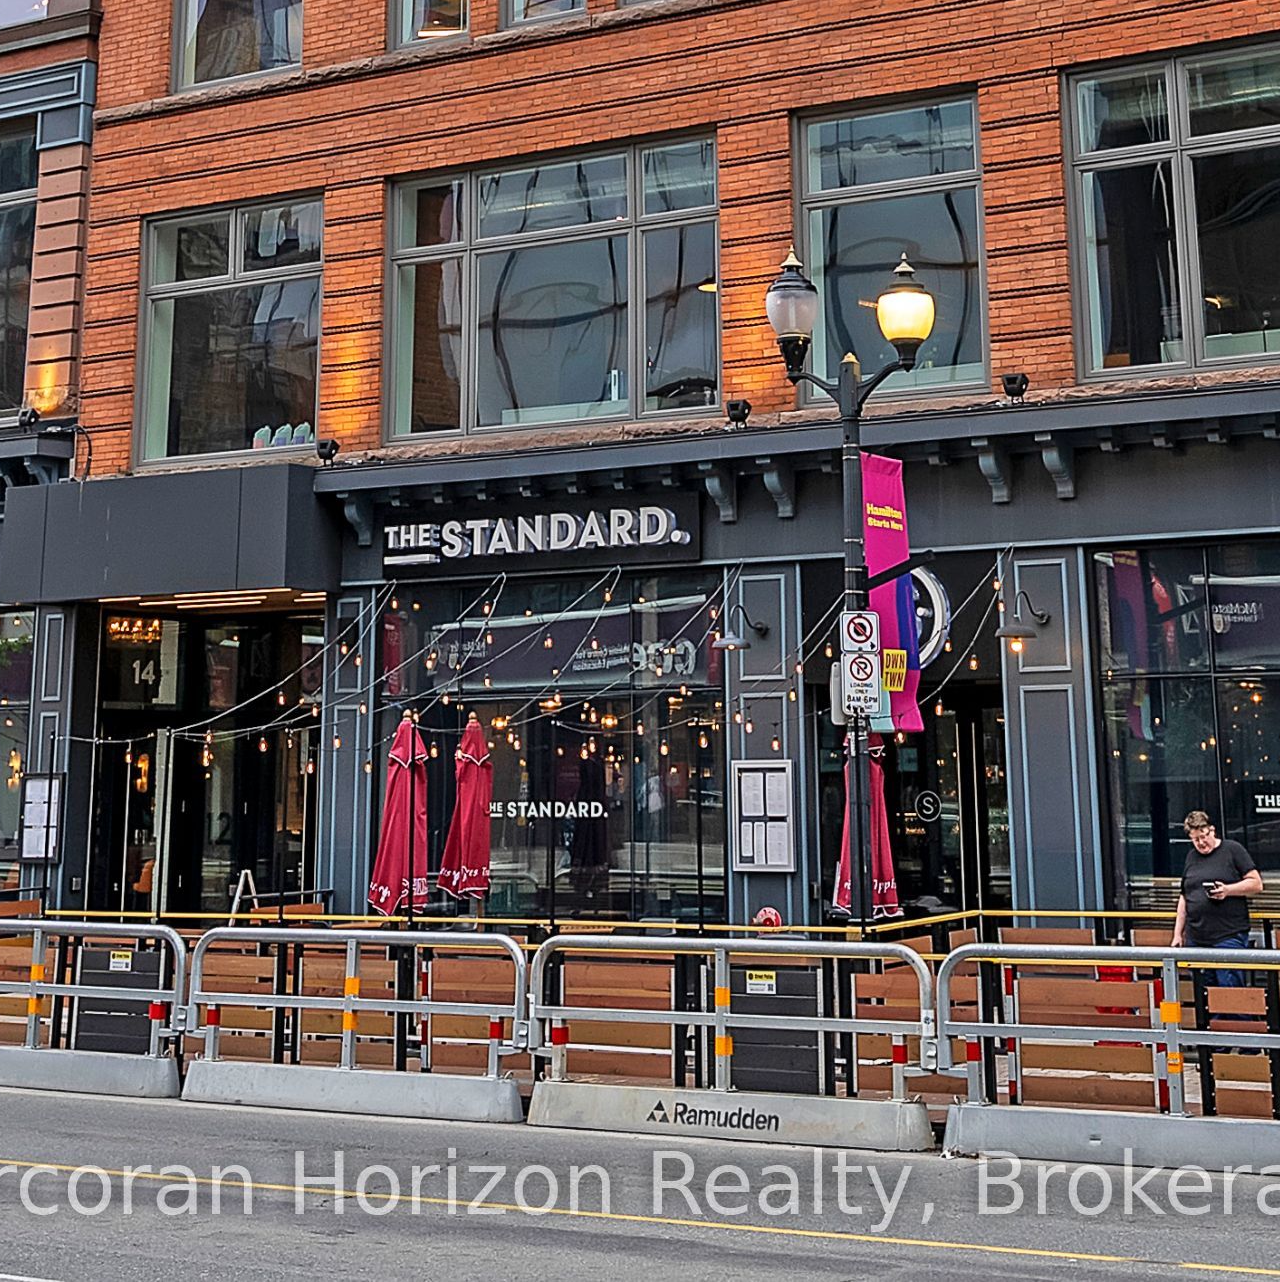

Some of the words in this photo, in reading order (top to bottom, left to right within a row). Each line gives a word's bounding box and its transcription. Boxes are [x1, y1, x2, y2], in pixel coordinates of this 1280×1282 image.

[866, 503, 902, 519] Hamilton
[384, 521, 440, 549] THE
[441, 506, 690, 558] STANDARD.
[867, 517, 890, 529] Starts
[885, 653, 905, 669] DWN
[132, 659, 156, 685] 14
[884, 671, 904, 688] TWN
[489, 801, 503, 813] HE
[506, 801, 609, 819] STANDARD.
[922, 797, 934, 815] S
[673, 1102, 780, 1132] Ramudden
